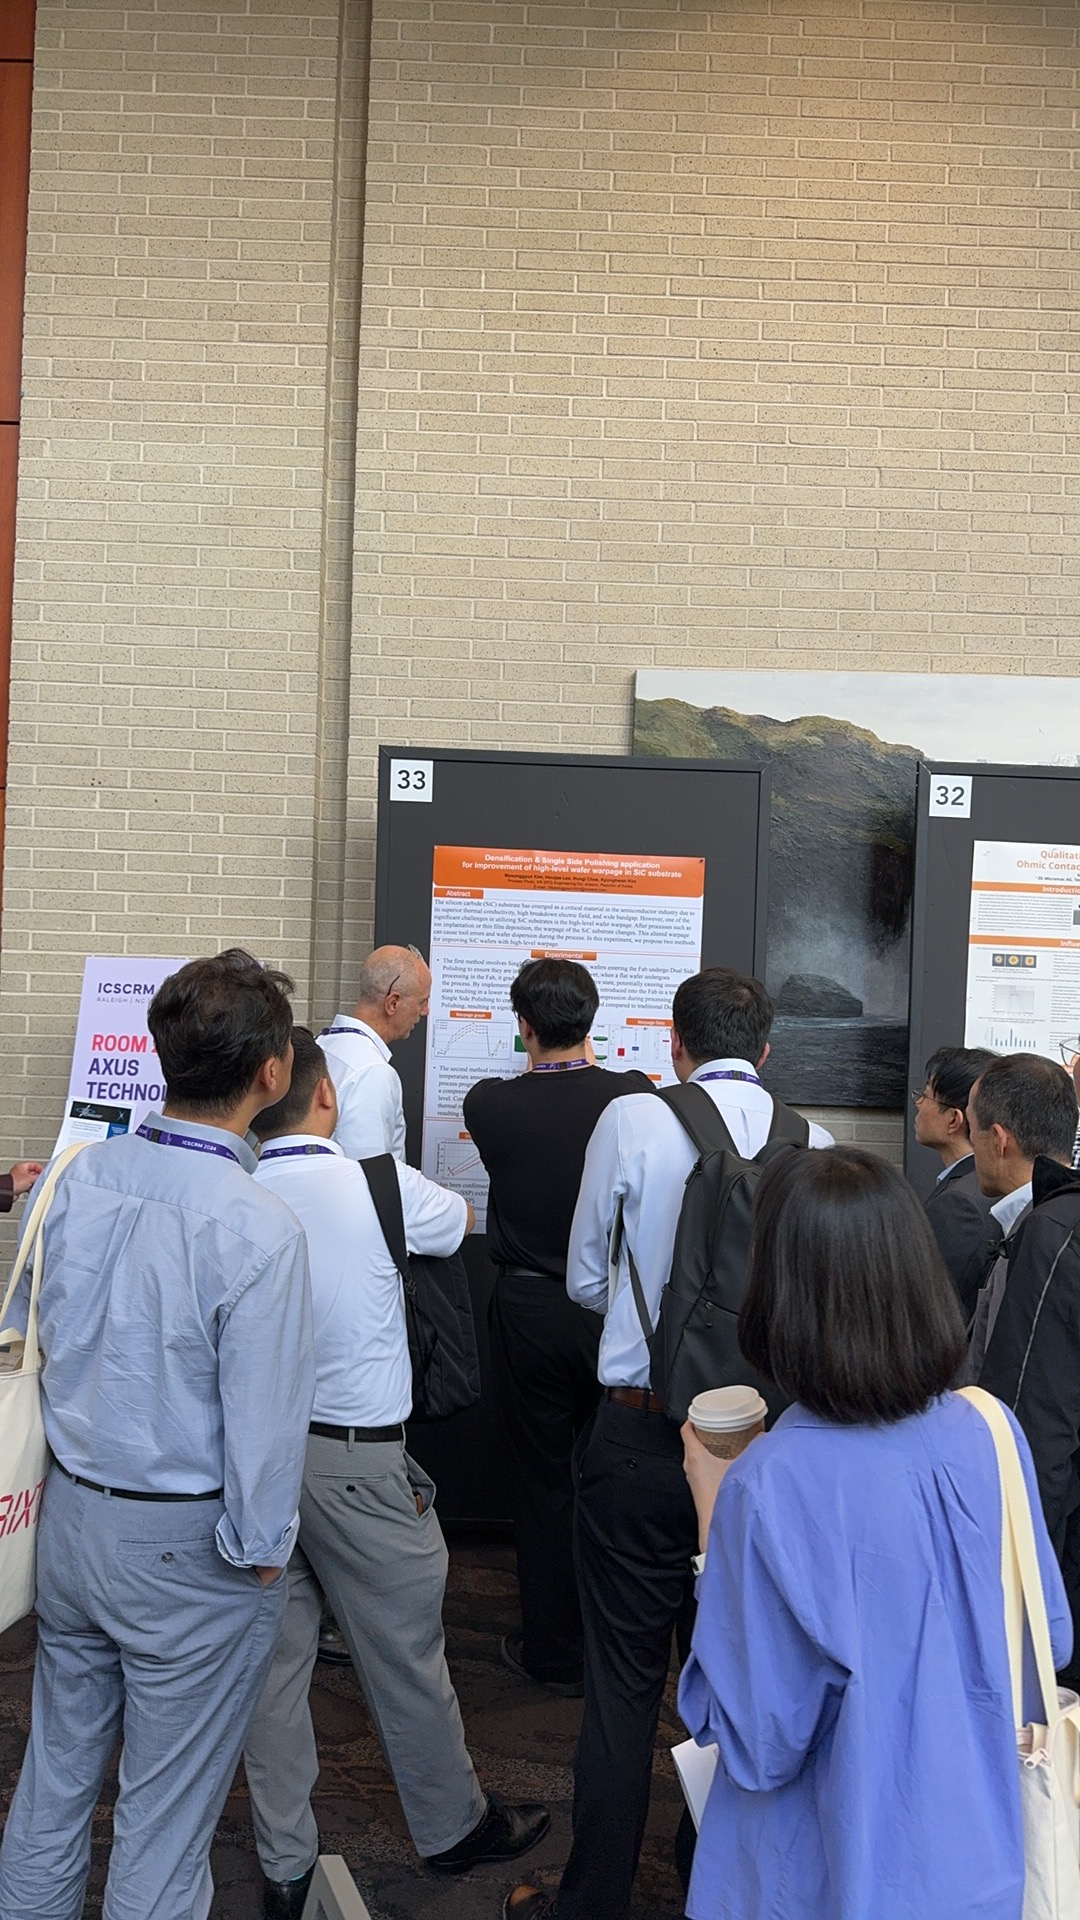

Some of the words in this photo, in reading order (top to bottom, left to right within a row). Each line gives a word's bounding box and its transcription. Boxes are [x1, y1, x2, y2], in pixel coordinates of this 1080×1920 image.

[398, 770, 426, 790] 33
[936, 786, 964, 806] 32
[533, 865, 569, 873] high-level
[542, 857, 565, 865] Single
[585, 859, 619, 867] Polishing
[620, 860, 660, 869] application
[1017, 860, 1046, 869] Ohmic
[98, 983, 155, 995] ICSCRM
[92, 1034, 148, 1053] ROOM
[88, 1058, 140, 1076] AXUS
[182, 1140, 203, 1149] ICSCRM
[204, 1143, 216, 1151] 2024
